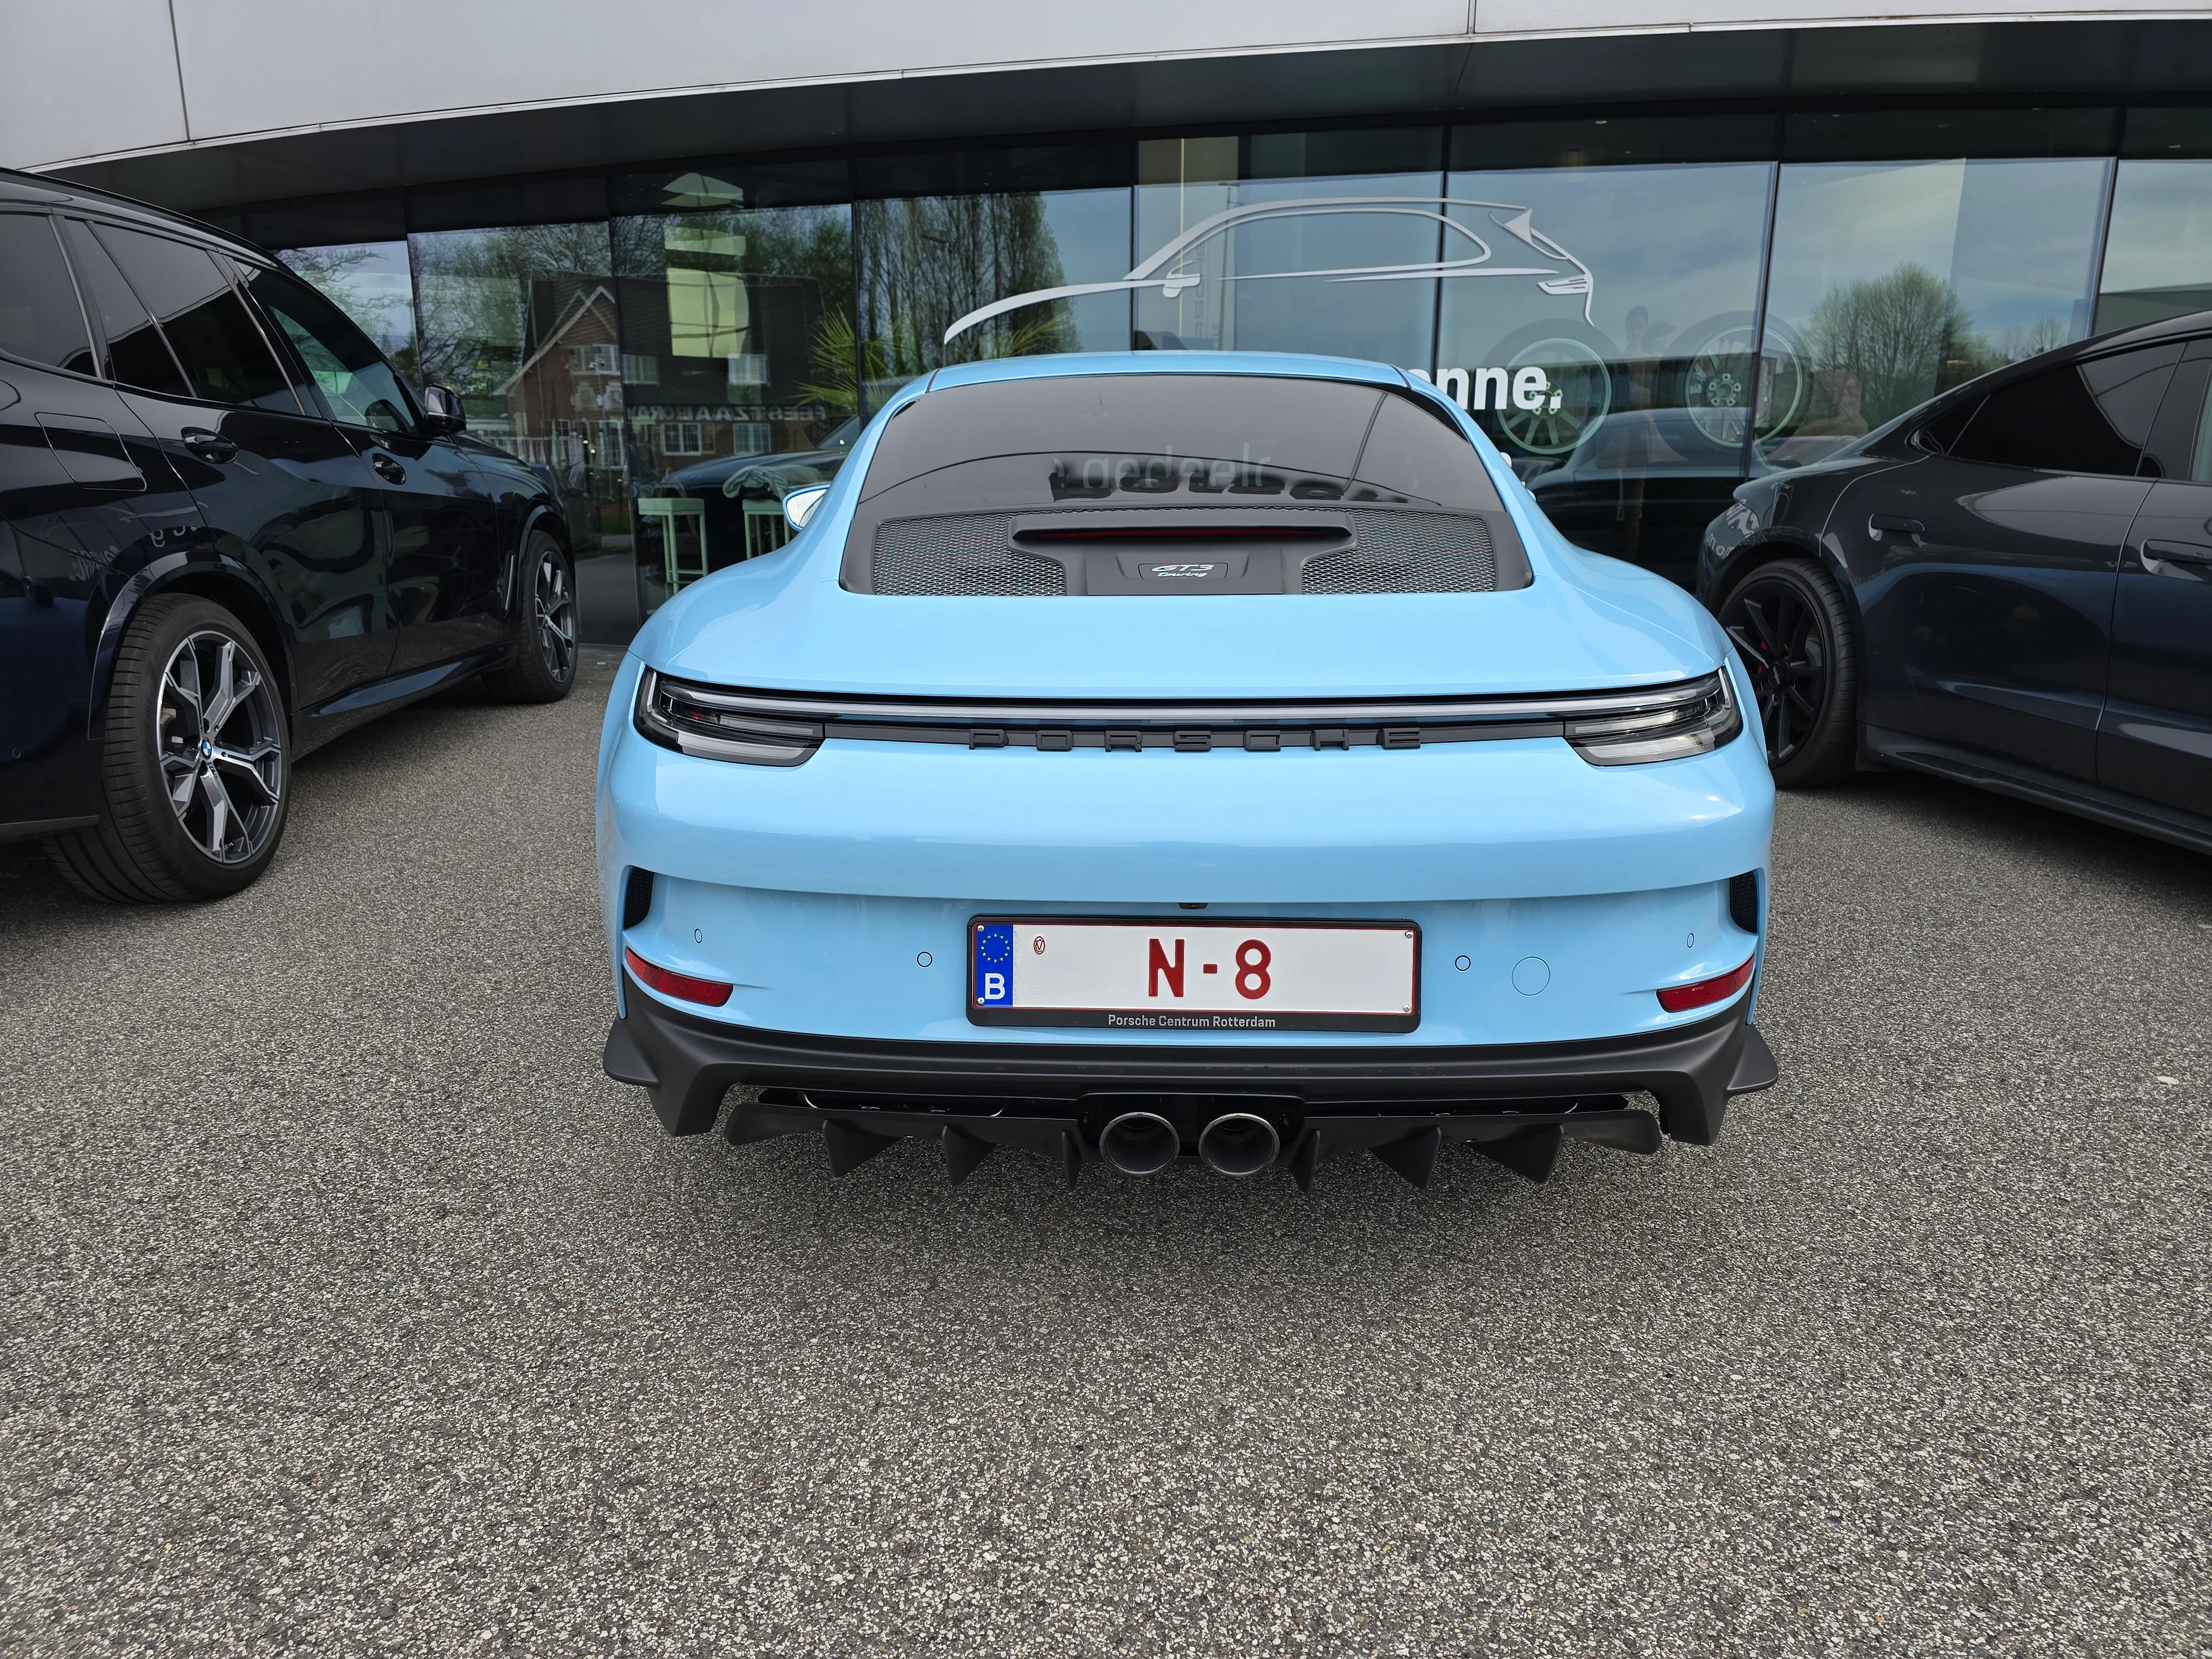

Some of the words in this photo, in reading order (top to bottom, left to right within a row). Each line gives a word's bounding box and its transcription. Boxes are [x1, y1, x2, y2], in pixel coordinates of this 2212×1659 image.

[969, 727, 1421, 752] PORSCHE
[984, 973, 1005, 1000] B
[1108, 1014, 1156, 1026] Porsche
[1159, 1015, 1209, 1027] Centrum
[1213, 1016, 1276, 1027] Rotterdam
